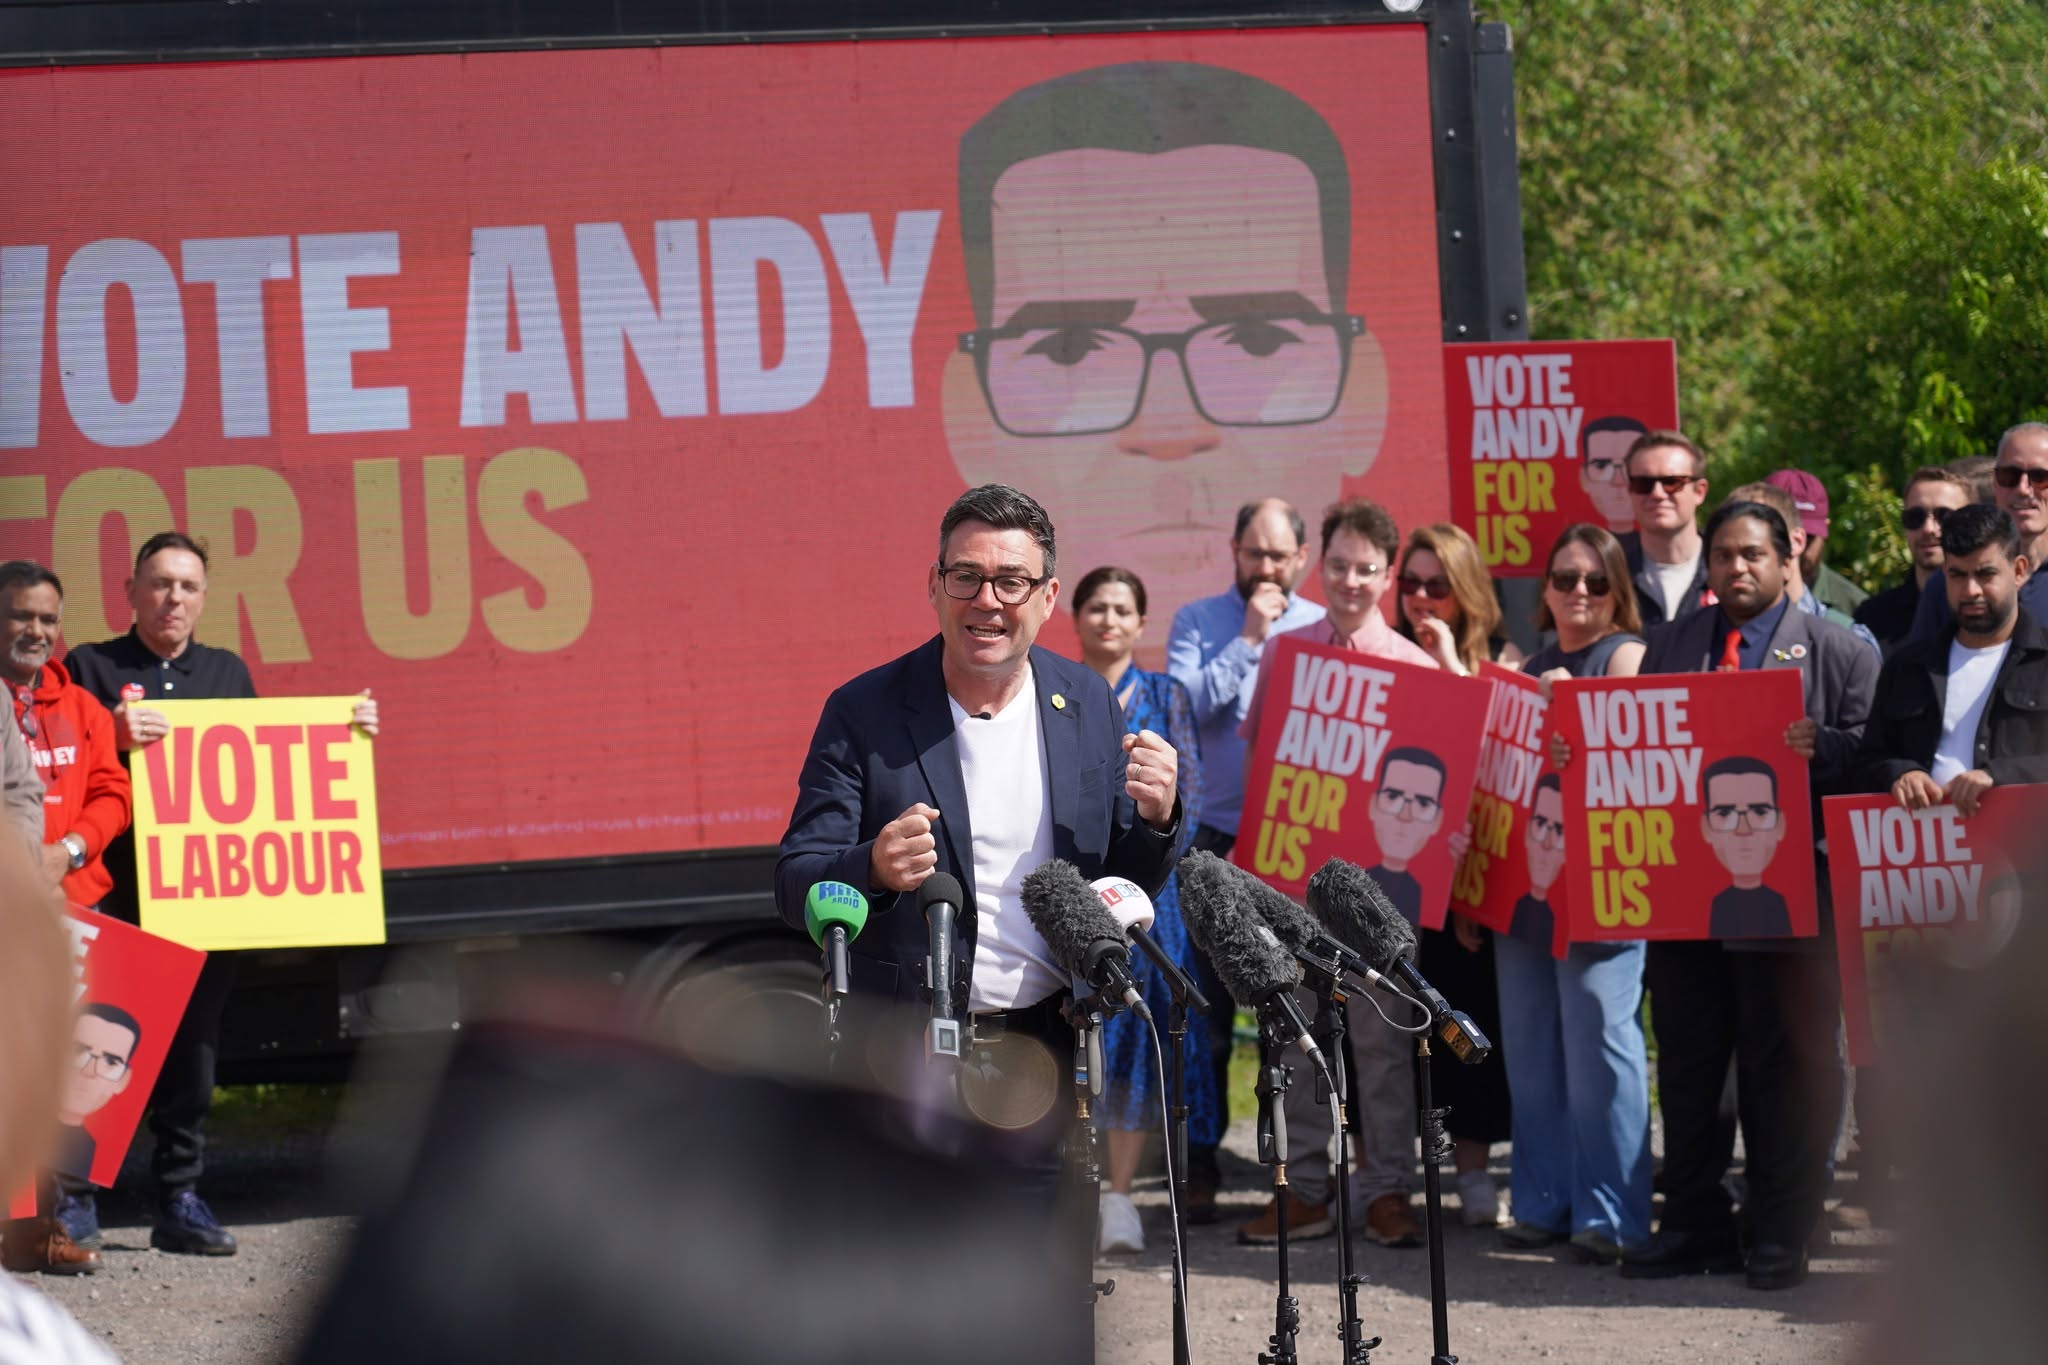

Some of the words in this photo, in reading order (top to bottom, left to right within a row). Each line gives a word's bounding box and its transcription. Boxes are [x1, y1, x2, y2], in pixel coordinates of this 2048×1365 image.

[460, 209, 942, 428] ANDY
[1466, 354, 1574, 407] VOTE
[1471, 407, 1583, 460] ANDY
[1473, 461, 1556, 512] FOR
[353, 446, 593, 661] US
[1476, 514, 1531, 566] US
[1291, 652, 1395, 726] VOTE
[1577, 687, 1693, 748] VOTE
[144, 724, 358, 825] VOTE
[1275, 709, 1392, 782] ANDY
[1475, 735, 1544, 808] ANDY
[1264, 764, 1347, 832] FOR
[1585, 747, 1703, 808] ANDY
[1254, 819, 1311, 881] US
[1468, 790, 1513, 860] FOR
[1587, 808, 1677, 867] FOR
[1849, 805, 1972, 867] VOTE
[146, 830, 365, 900] LABOUR
[1101, 883, 1142, 905] LBC
[1860, 863, 1983, 928] ANDY
[832, 896, 859, 909] RADIO
[1591, 868, 1652, 928] US
